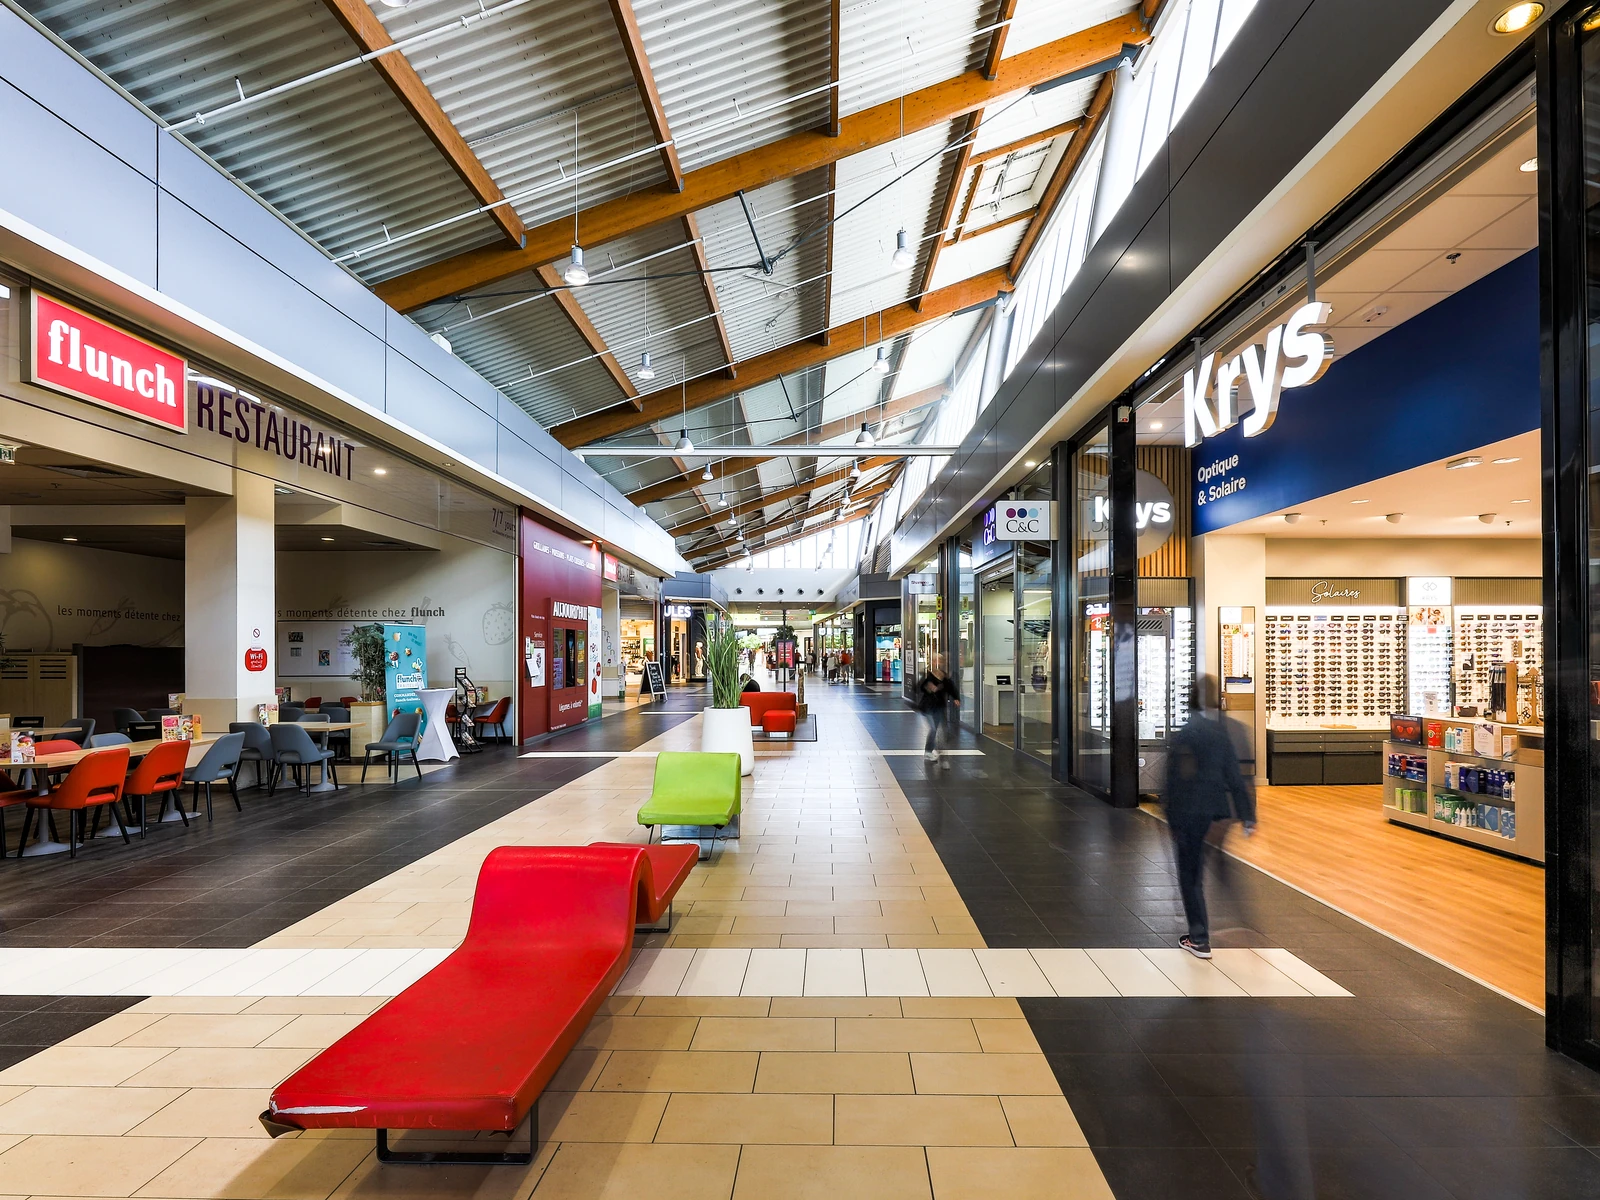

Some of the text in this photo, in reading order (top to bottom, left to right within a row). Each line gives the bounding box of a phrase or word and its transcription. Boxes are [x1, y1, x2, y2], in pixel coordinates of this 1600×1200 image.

[47, 318, 177, 408] flunch
[1183, 301, 1333, 448] Krys
[196, 381, 355, 481] RESTAURANT
[1197, 453, 1240, 484] Optique
[1197, 476, 1247, 506] & Solaire
[1005, 519, 1040, 533] C&C
[1094, 496, 1171, 529] Kys
[1311, 580, 1361, 604] Solaires
[57, 604, 181, 622] les moments détente chez
[286, 609, 333, 618] moments
[337, 607, 378, 618] détente
[382, 608, 406, 618] chez
[411, 606, 445, 618] flunch
[664, 605, 692, 618] ULES
